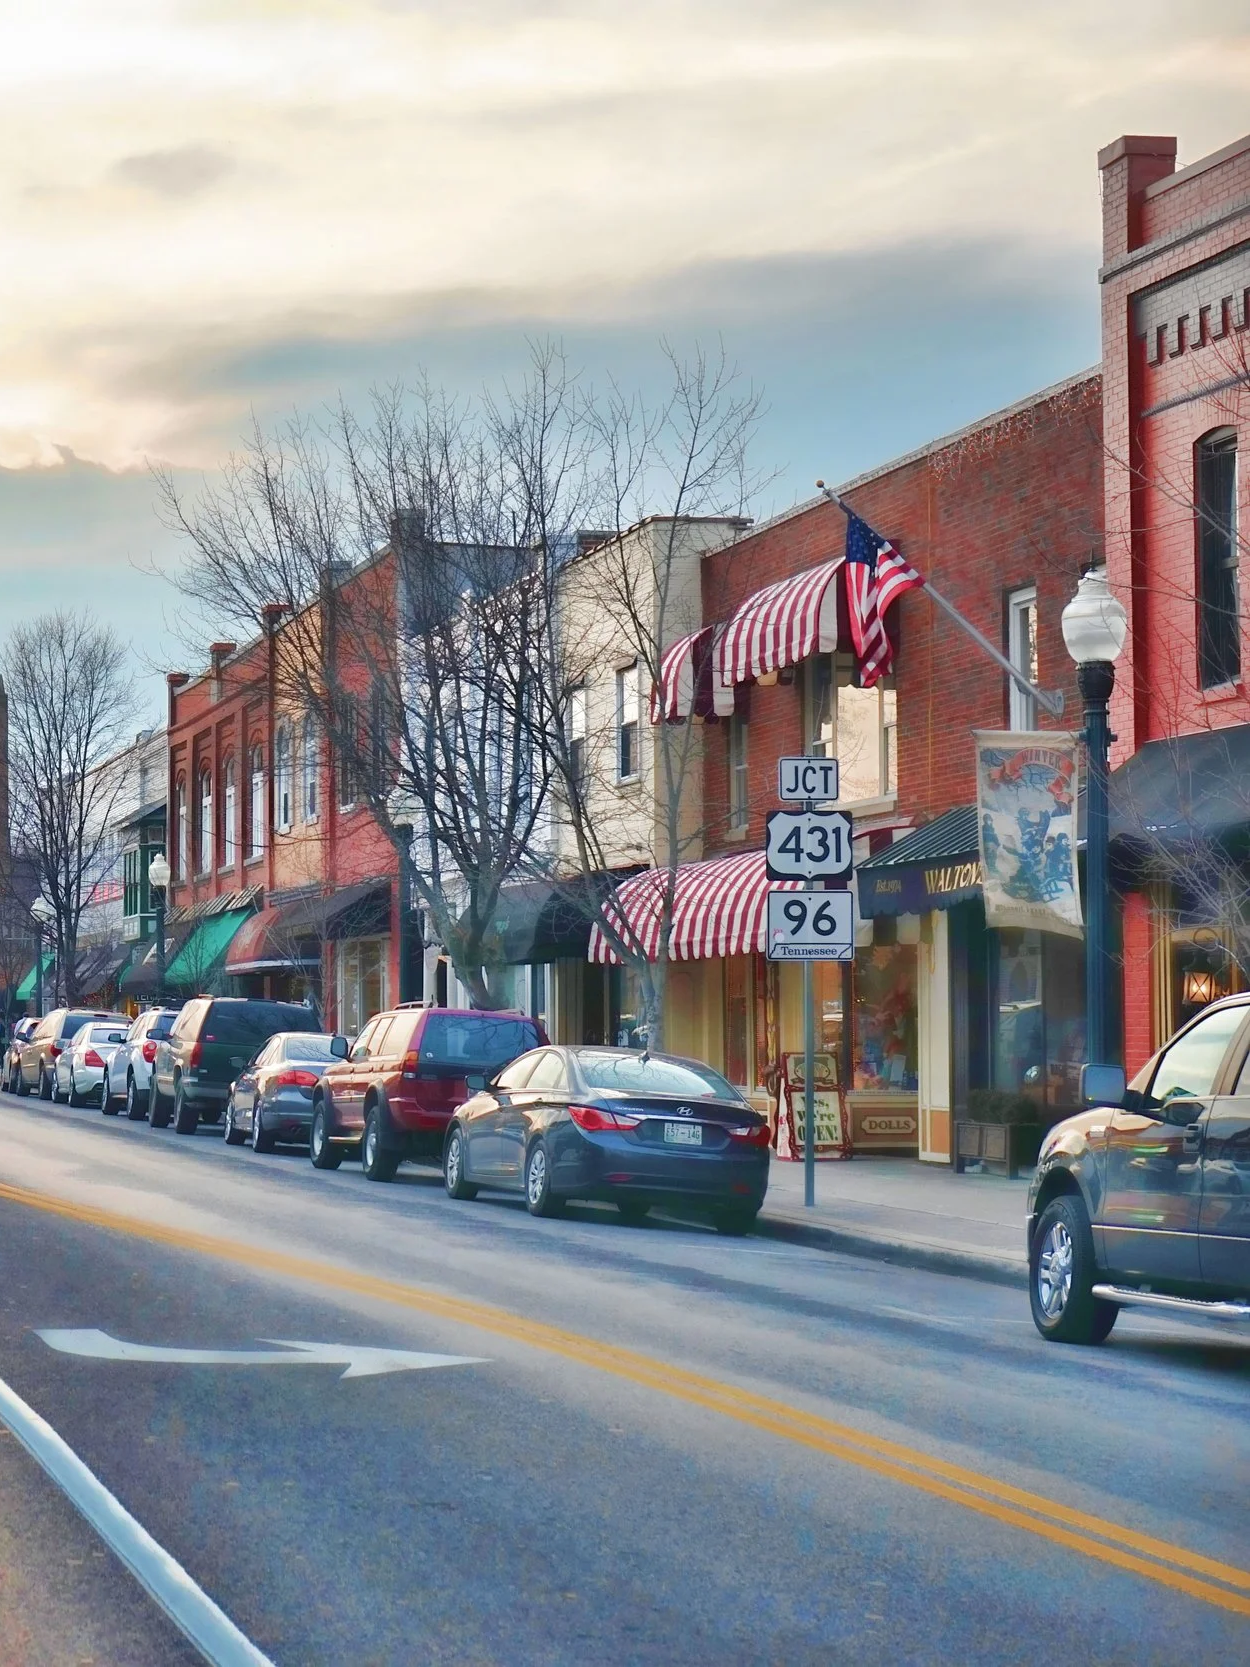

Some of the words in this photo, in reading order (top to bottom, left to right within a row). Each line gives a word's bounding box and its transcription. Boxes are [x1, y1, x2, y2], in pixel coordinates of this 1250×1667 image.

[1022, 749, 1061, 771] WINTER
[786, 766, 833, 794] JCT
[778, 826, 842, 863] 431
[783, 900, 837, 937] 96
[781, 946, 837, 957] Tennessee
[797, 1125, 839, 1142] OEN!
[868, 1119, 911, 1130] DOLLS
